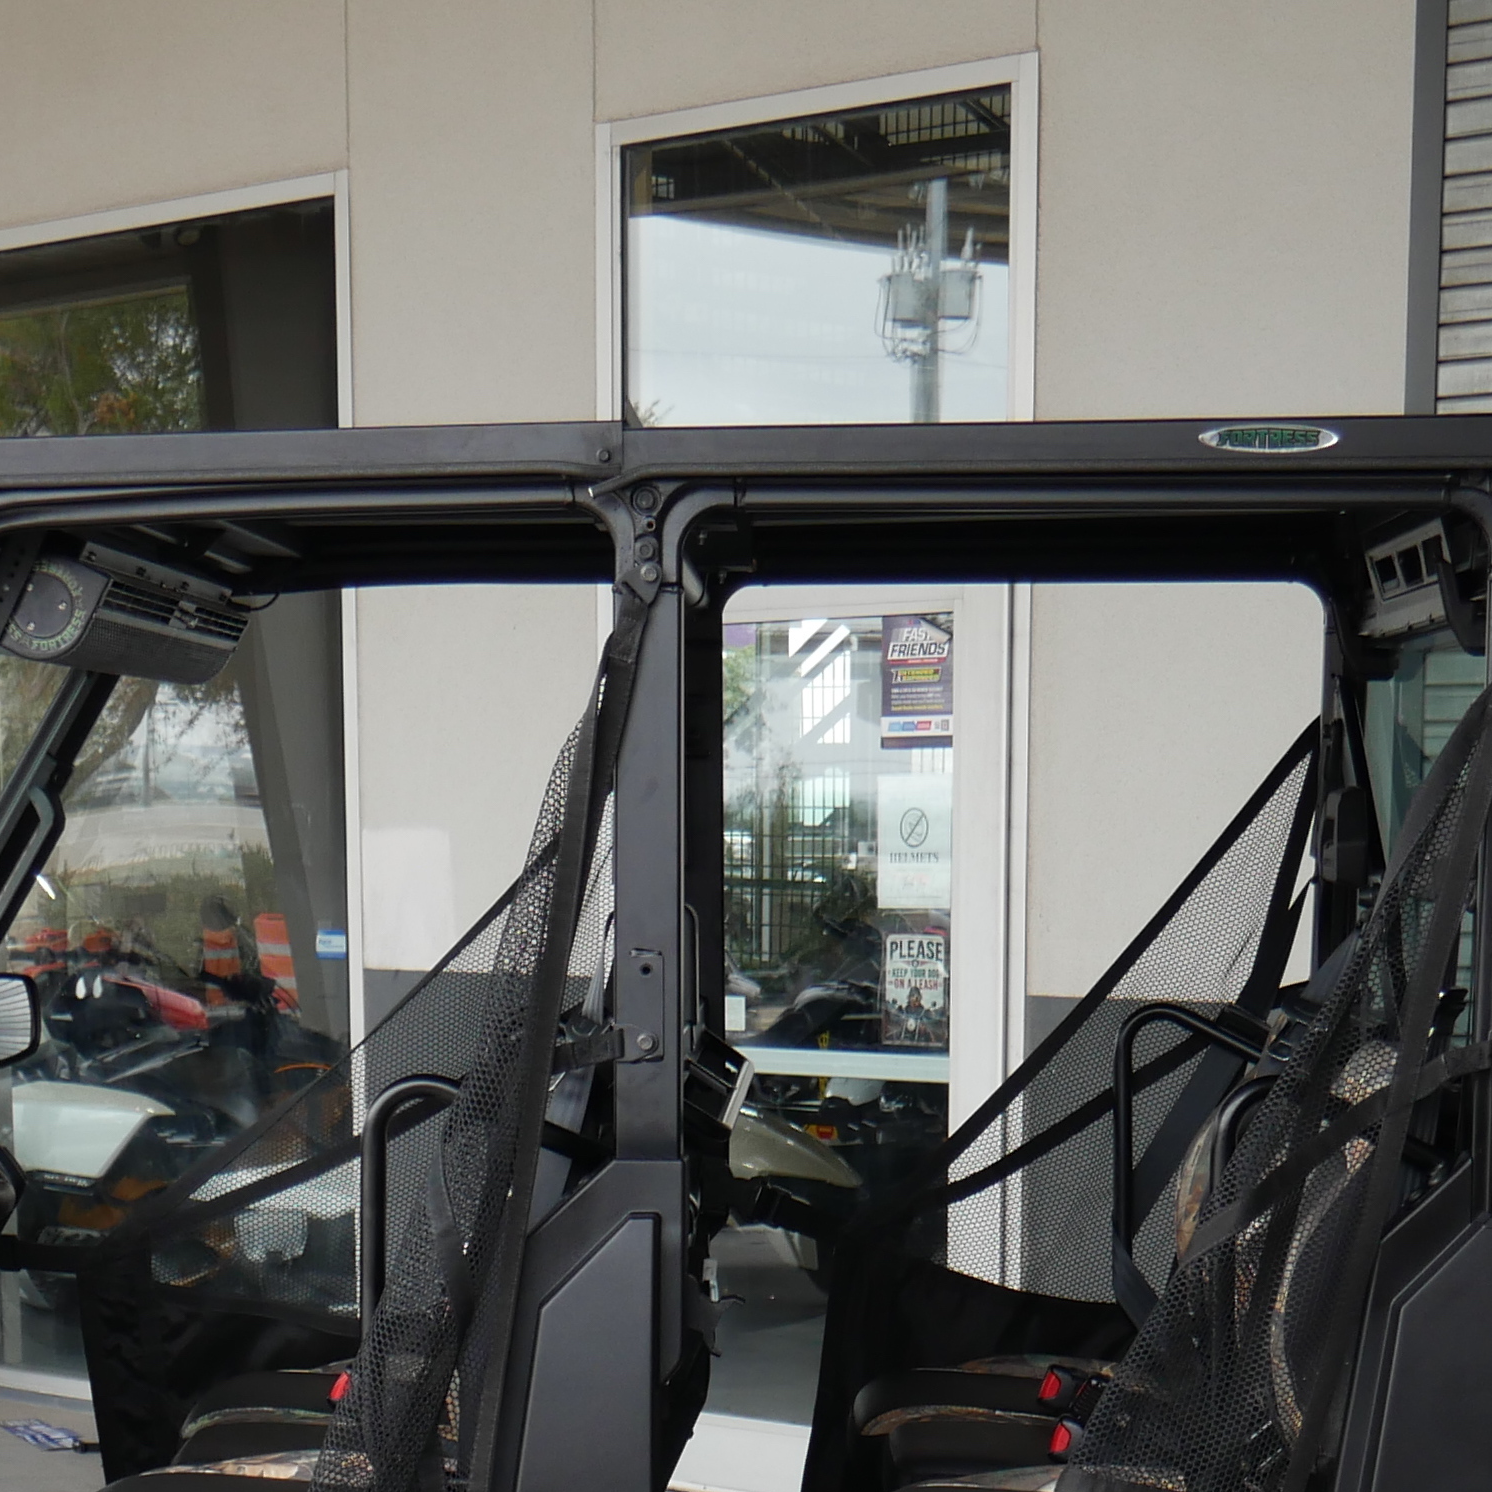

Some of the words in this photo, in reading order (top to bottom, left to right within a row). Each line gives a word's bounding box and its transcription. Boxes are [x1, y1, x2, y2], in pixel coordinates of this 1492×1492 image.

[1216, 428, 1321, 448] FORTRESS
[890, 642, 946, 658] FRIENDS
[889, 852, 939, 863] HELMETS
[890, 940, 944, 961] PLEASE
[892, 968, 908, 978] KEEP
[910, 968, 926, 978] YOUR
[894, 979, 905, 989] ON
[914, 979, 939, 990] LEASH
